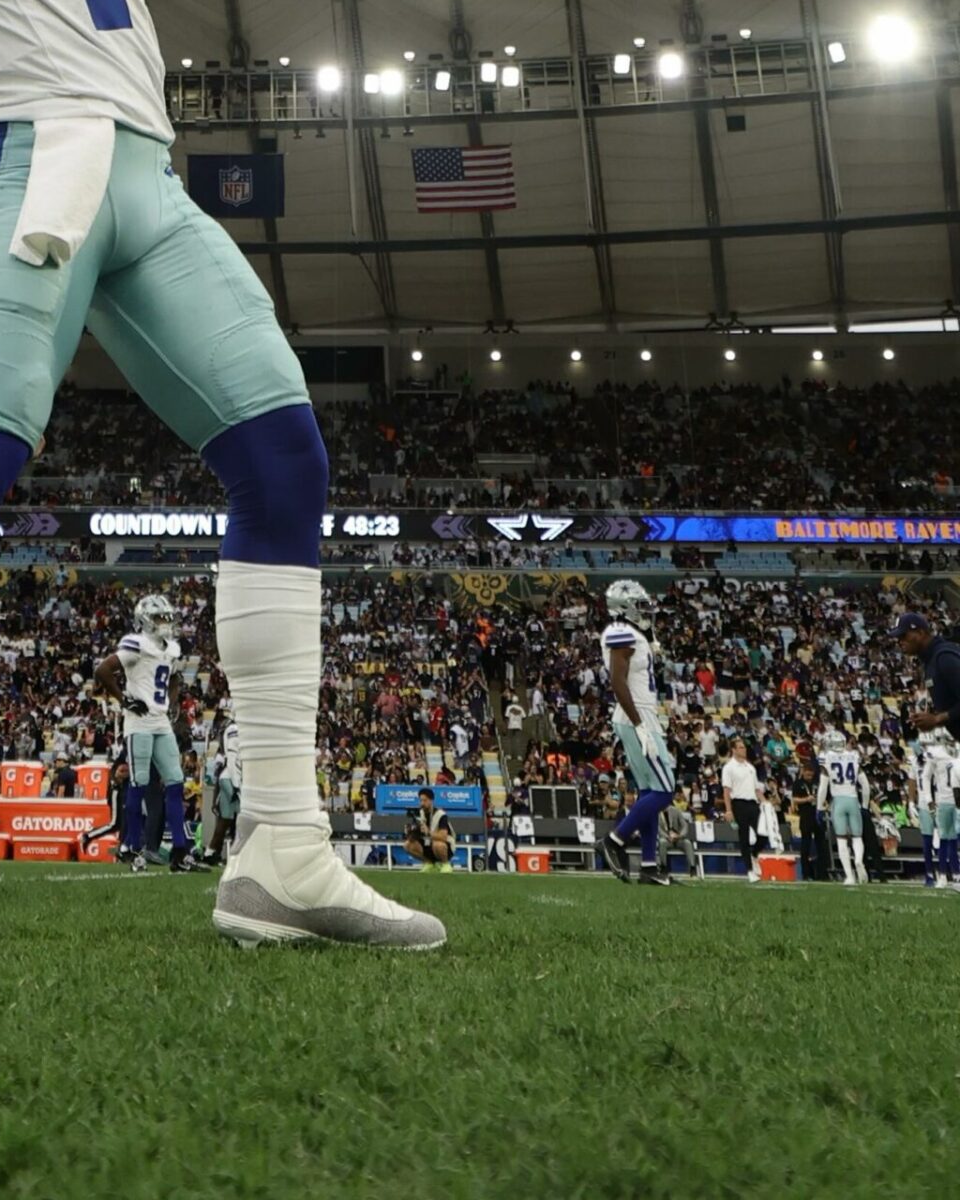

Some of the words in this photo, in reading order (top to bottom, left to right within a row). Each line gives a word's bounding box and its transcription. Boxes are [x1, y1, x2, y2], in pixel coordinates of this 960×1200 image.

[224, 183, 249, 200] NFL
[89, 513, 213, 536] COUNTDOWN
[215, 513, 229, 536] T
[343, 515, 400, 536] 48:23
[775, 520, 898, 539] BALTIMORE
[154, 664, 169, 705] 9
[5, 768, 17, 782] G
[23, 772, 35, 786] G
[90, 769, 102, 783] G
[831, 762, 855, 786] 34
[11, 816, 94, 831] GATORADE
[20, 846, 59, 855] GATORADE
[87, 842, 100, 857] G
[527, 856, 540, 871] G
